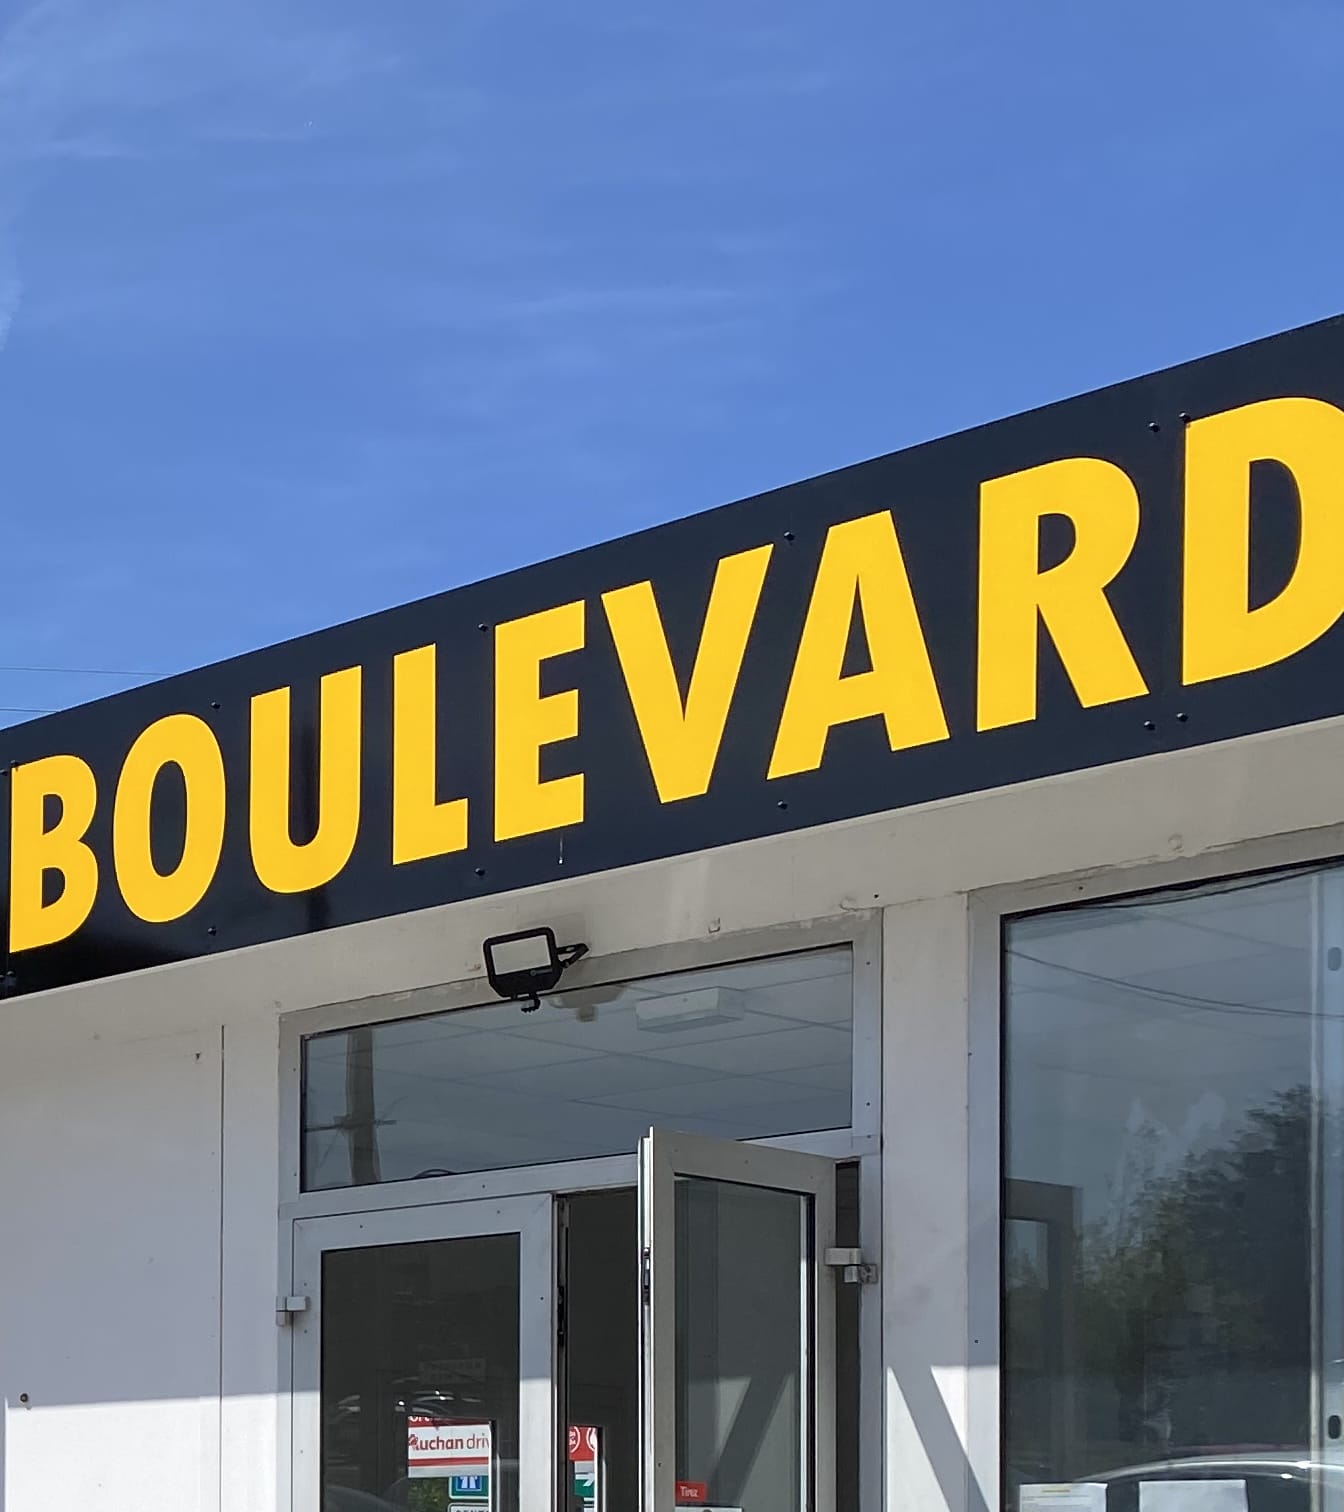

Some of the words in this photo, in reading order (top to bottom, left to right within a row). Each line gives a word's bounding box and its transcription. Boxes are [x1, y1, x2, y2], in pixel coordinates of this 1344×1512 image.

[8, 397, 1344, 953] BOULEVARD
[408, 1433, 464, 1451] Auchan
[466, 1432, 490, 1449] dri
